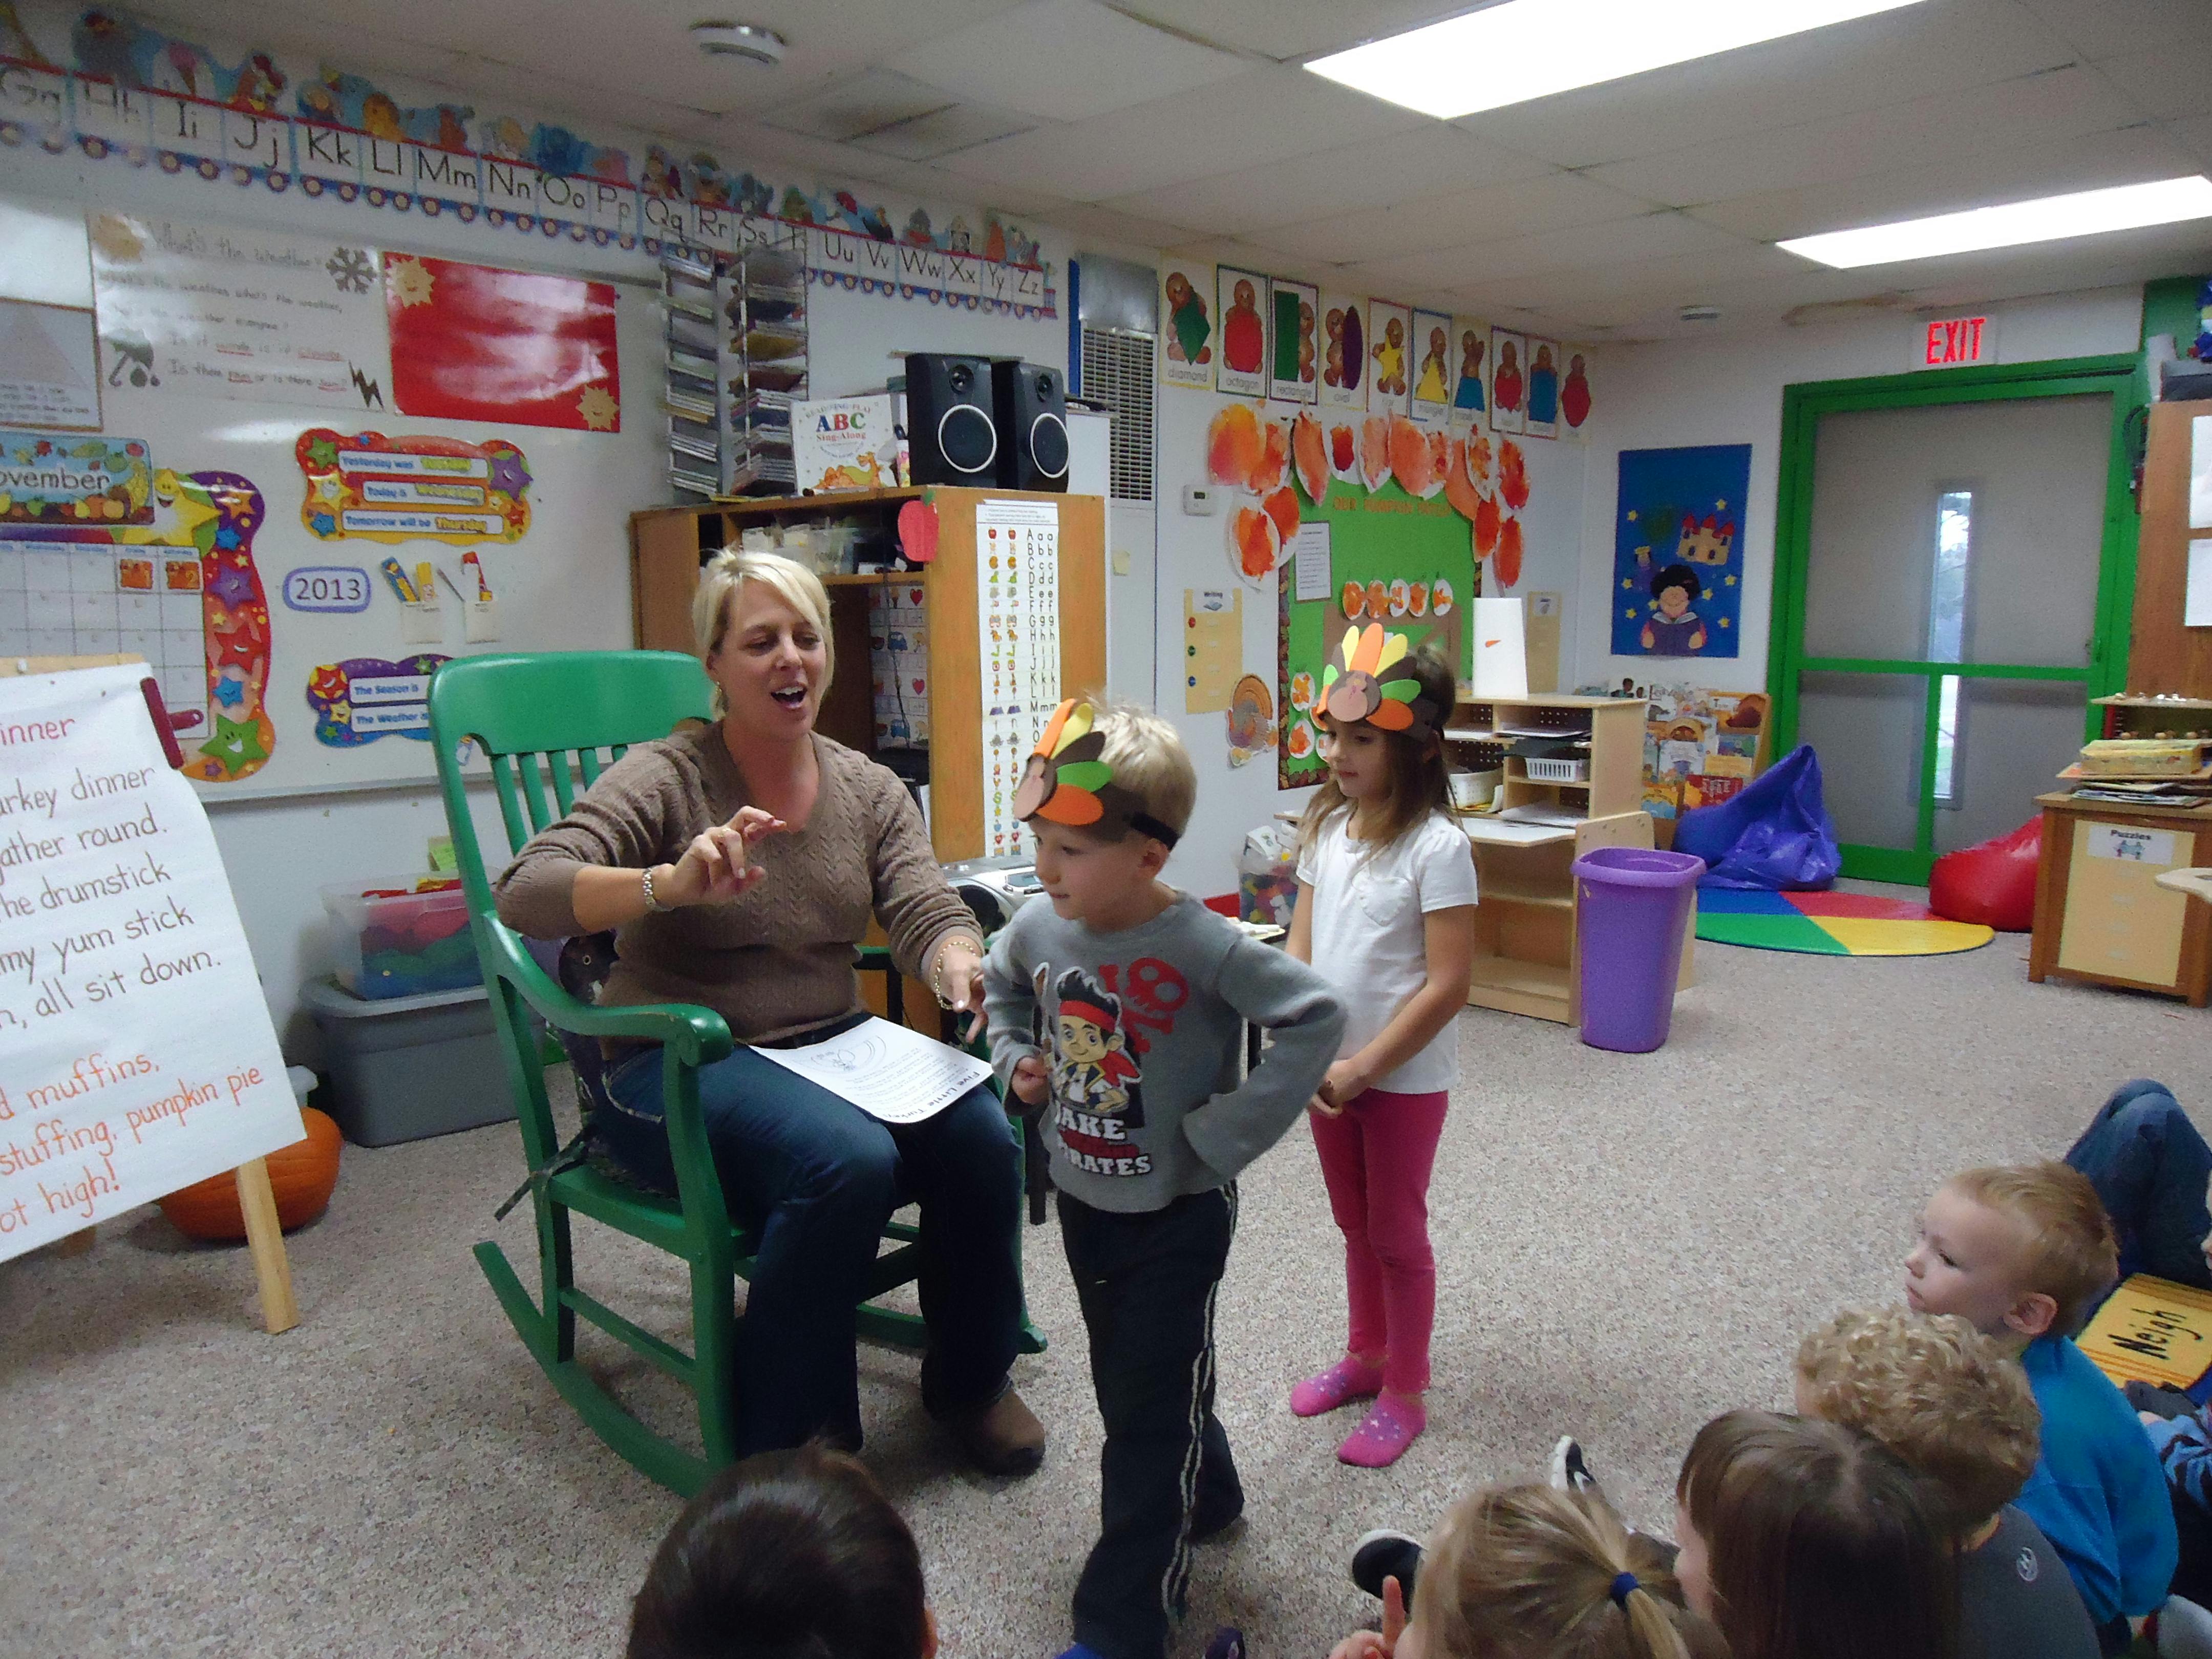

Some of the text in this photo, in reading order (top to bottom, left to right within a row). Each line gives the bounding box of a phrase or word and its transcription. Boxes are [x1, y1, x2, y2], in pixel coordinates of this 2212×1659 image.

[307, 127, 352, 166] Kk
[418, 148, 477, 189] Mm
[489, 163, 531, 199] Nn
[543, 176, 586, 208] Oo
[644, 198, 687, 243] Qq
[698, 210, 728, 238] Rr
[824, 232, 854, 265] Uu
[867, 244, 889, 270] Vv
[901, 251, 941, 279] Ww
[950, 261, 975, 284] Xx
[988, 264, 1005, 297] Yy
[1019, 270, 1039, 295] Zz
[1926, 317, 1986, 365] EXIT
[816, 412, 866, 433] ABC
[816, 431, 867, 443] Sing-Along
[295, 578, 361, 601] 2013
[71, 766, 156, 802] dinner
[78, 802, 168, 850] round.
[2110, 828, 2152, 841] Puzzles
[39, 852, 172, 910] drumstick
[53, 922, 115, 974] yum
[123, 896, 196, 941] stick
[35, 977, 74, 1017] all
[85, 969, 129, 1003] sit
[139, 951, 221, 988] down.
[126, 1078, 219, 1145] pumpkin
[226, 1065, 265, 1106] pie
[37, 1157, 121, 1219] high!
